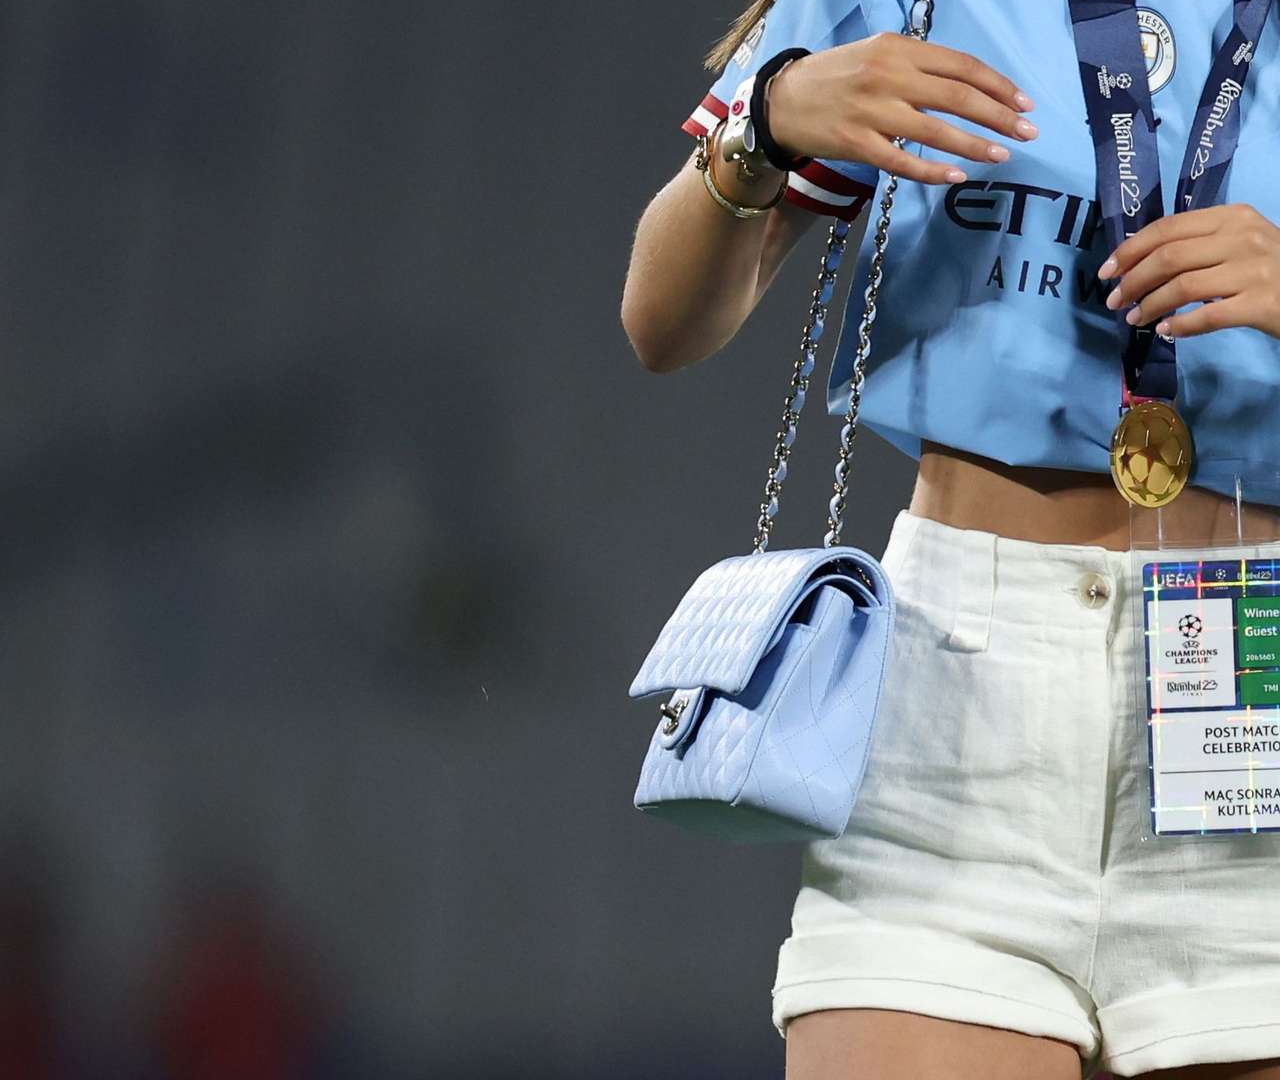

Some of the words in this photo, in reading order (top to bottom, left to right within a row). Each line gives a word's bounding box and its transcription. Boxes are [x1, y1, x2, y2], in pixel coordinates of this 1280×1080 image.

[1136, 13, 1171, 45] HESTER
[1244, 626, 1278, 637] Guest
[1165, 648, 1218, 658] CHAMPIONS
[1175, 656, 1210, 665] LEAGUE
[1205, 726, 1239, 738] POST
[1204, 789, 1234, 803] MAÇ
